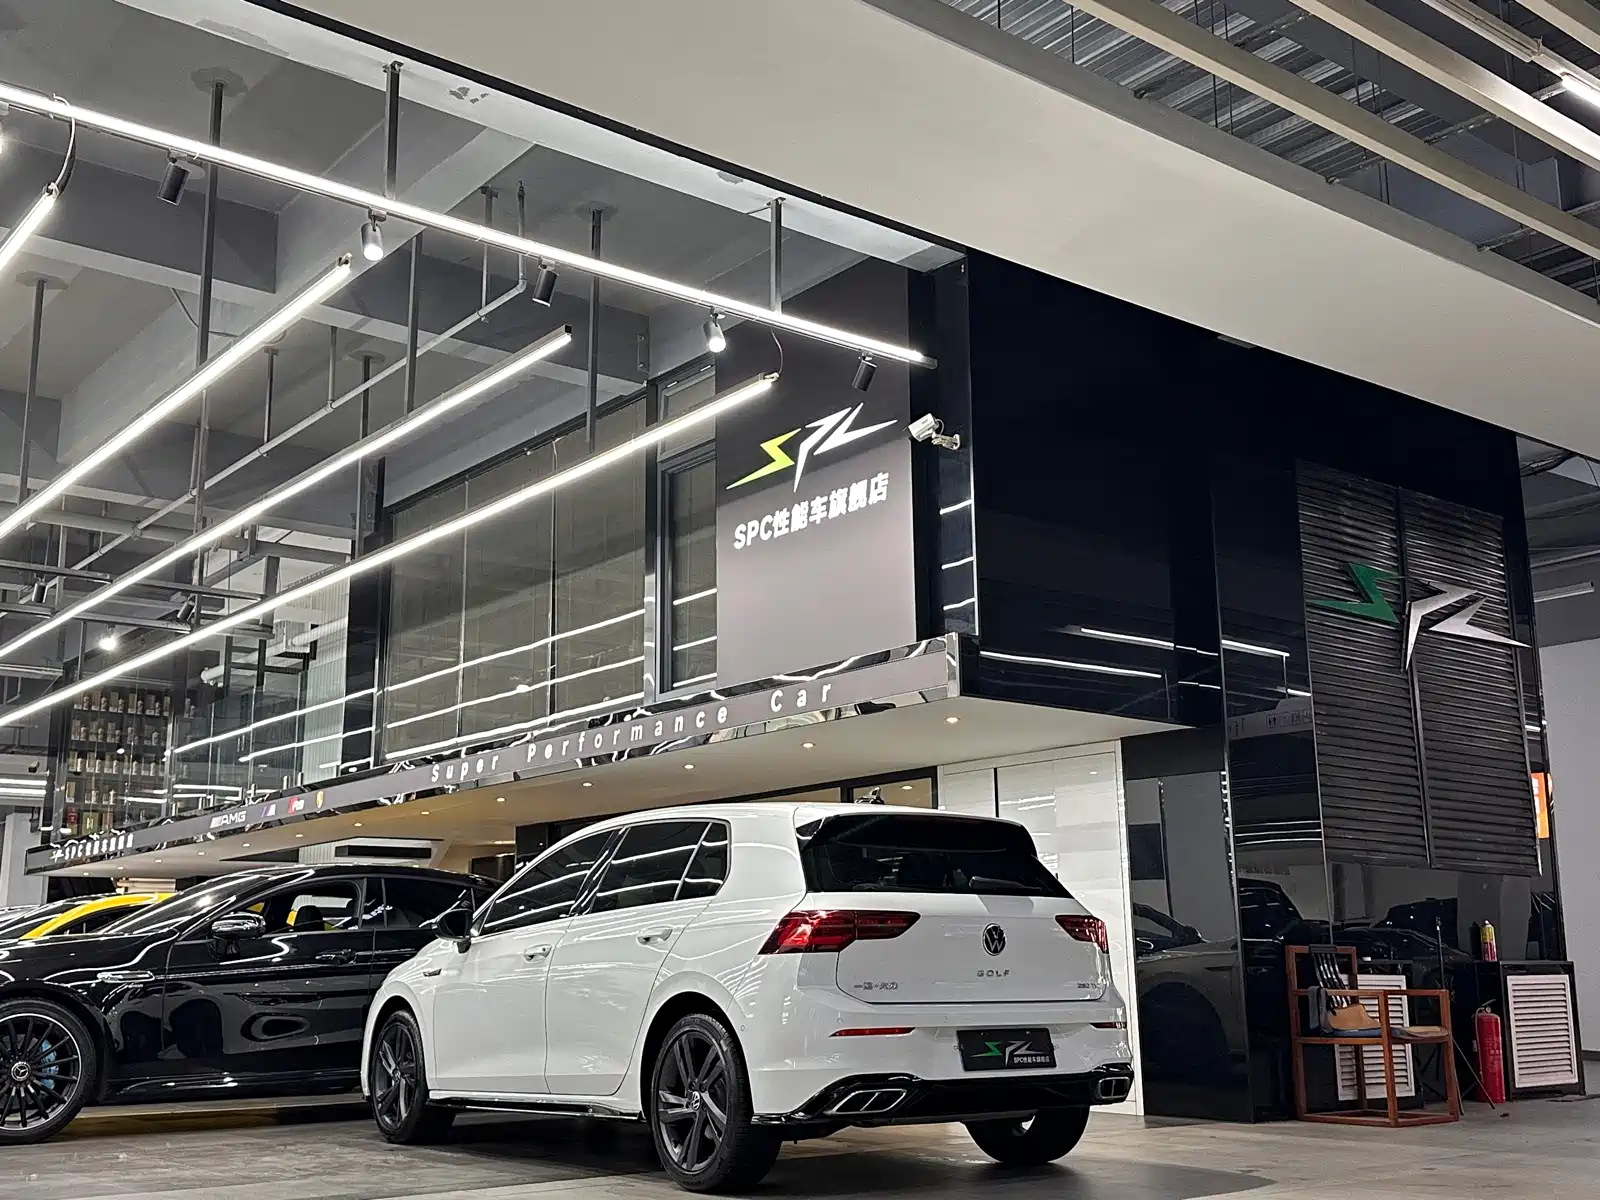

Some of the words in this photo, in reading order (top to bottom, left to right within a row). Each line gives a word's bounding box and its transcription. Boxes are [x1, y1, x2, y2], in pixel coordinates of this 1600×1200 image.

[733, 472, 890, 550] SPC性能车旗舰店
[431, 755, 499, 783] Super
[527, 705, 729, 763] Performance
[770, 683, 832, 713] Car
[217, 810, 247, 827] AMG
[976, 969, 1010, 978] GOLF
